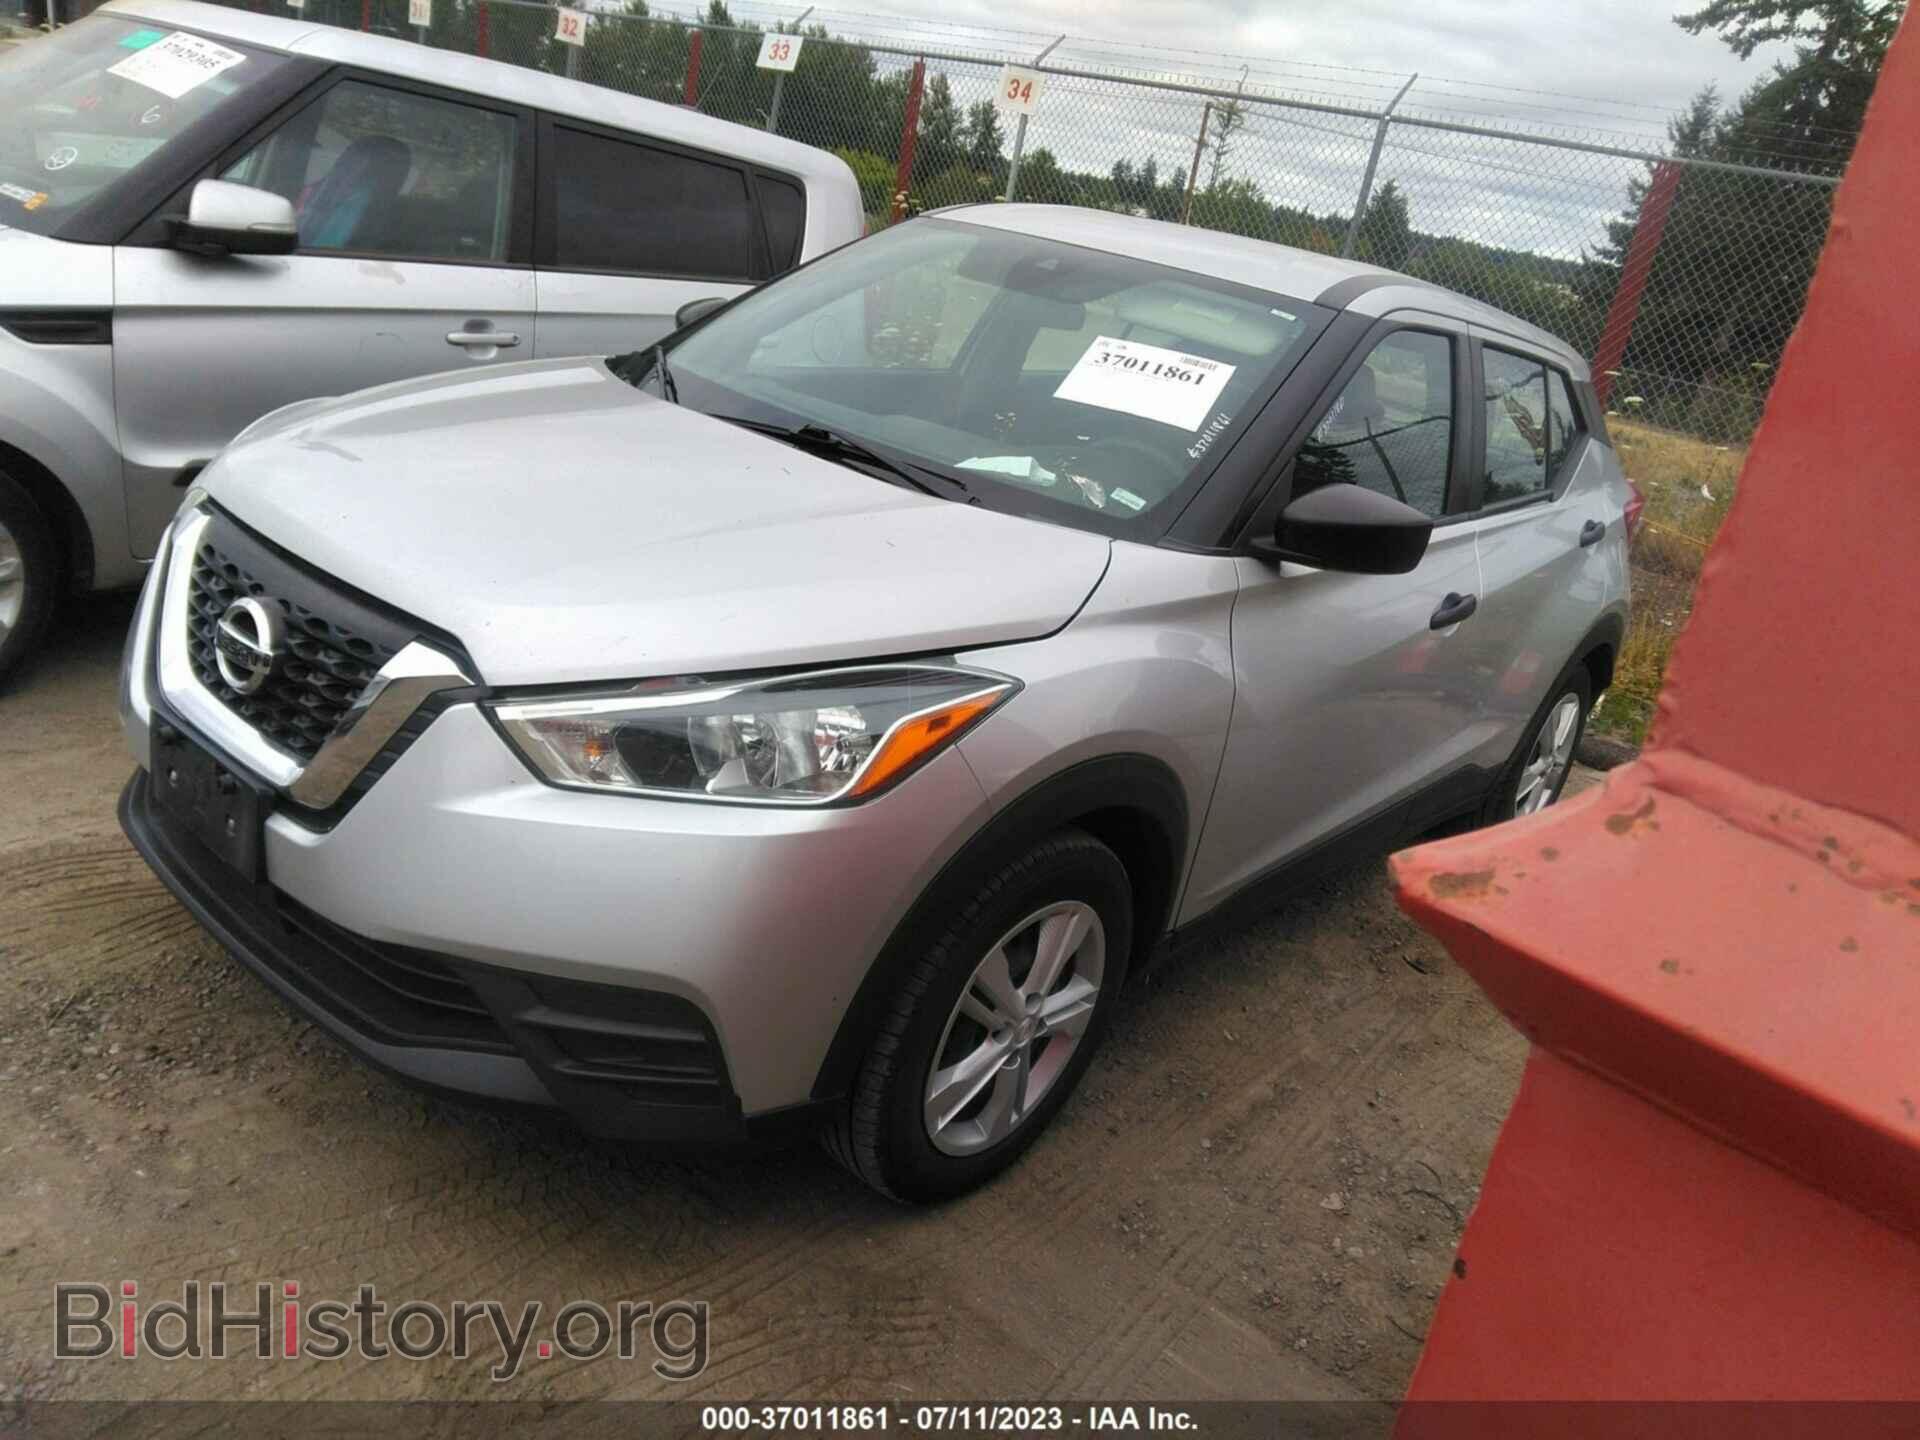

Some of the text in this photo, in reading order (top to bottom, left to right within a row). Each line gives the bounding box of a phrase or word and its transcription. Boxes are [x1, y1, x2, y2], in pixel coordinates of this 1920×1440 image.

[561, 16, 578, 37] 32
[767, 40, 790, 62] 33
[1007, 78, 1033, 104] 34
[1093, 351, 1206, 386] 37011861
